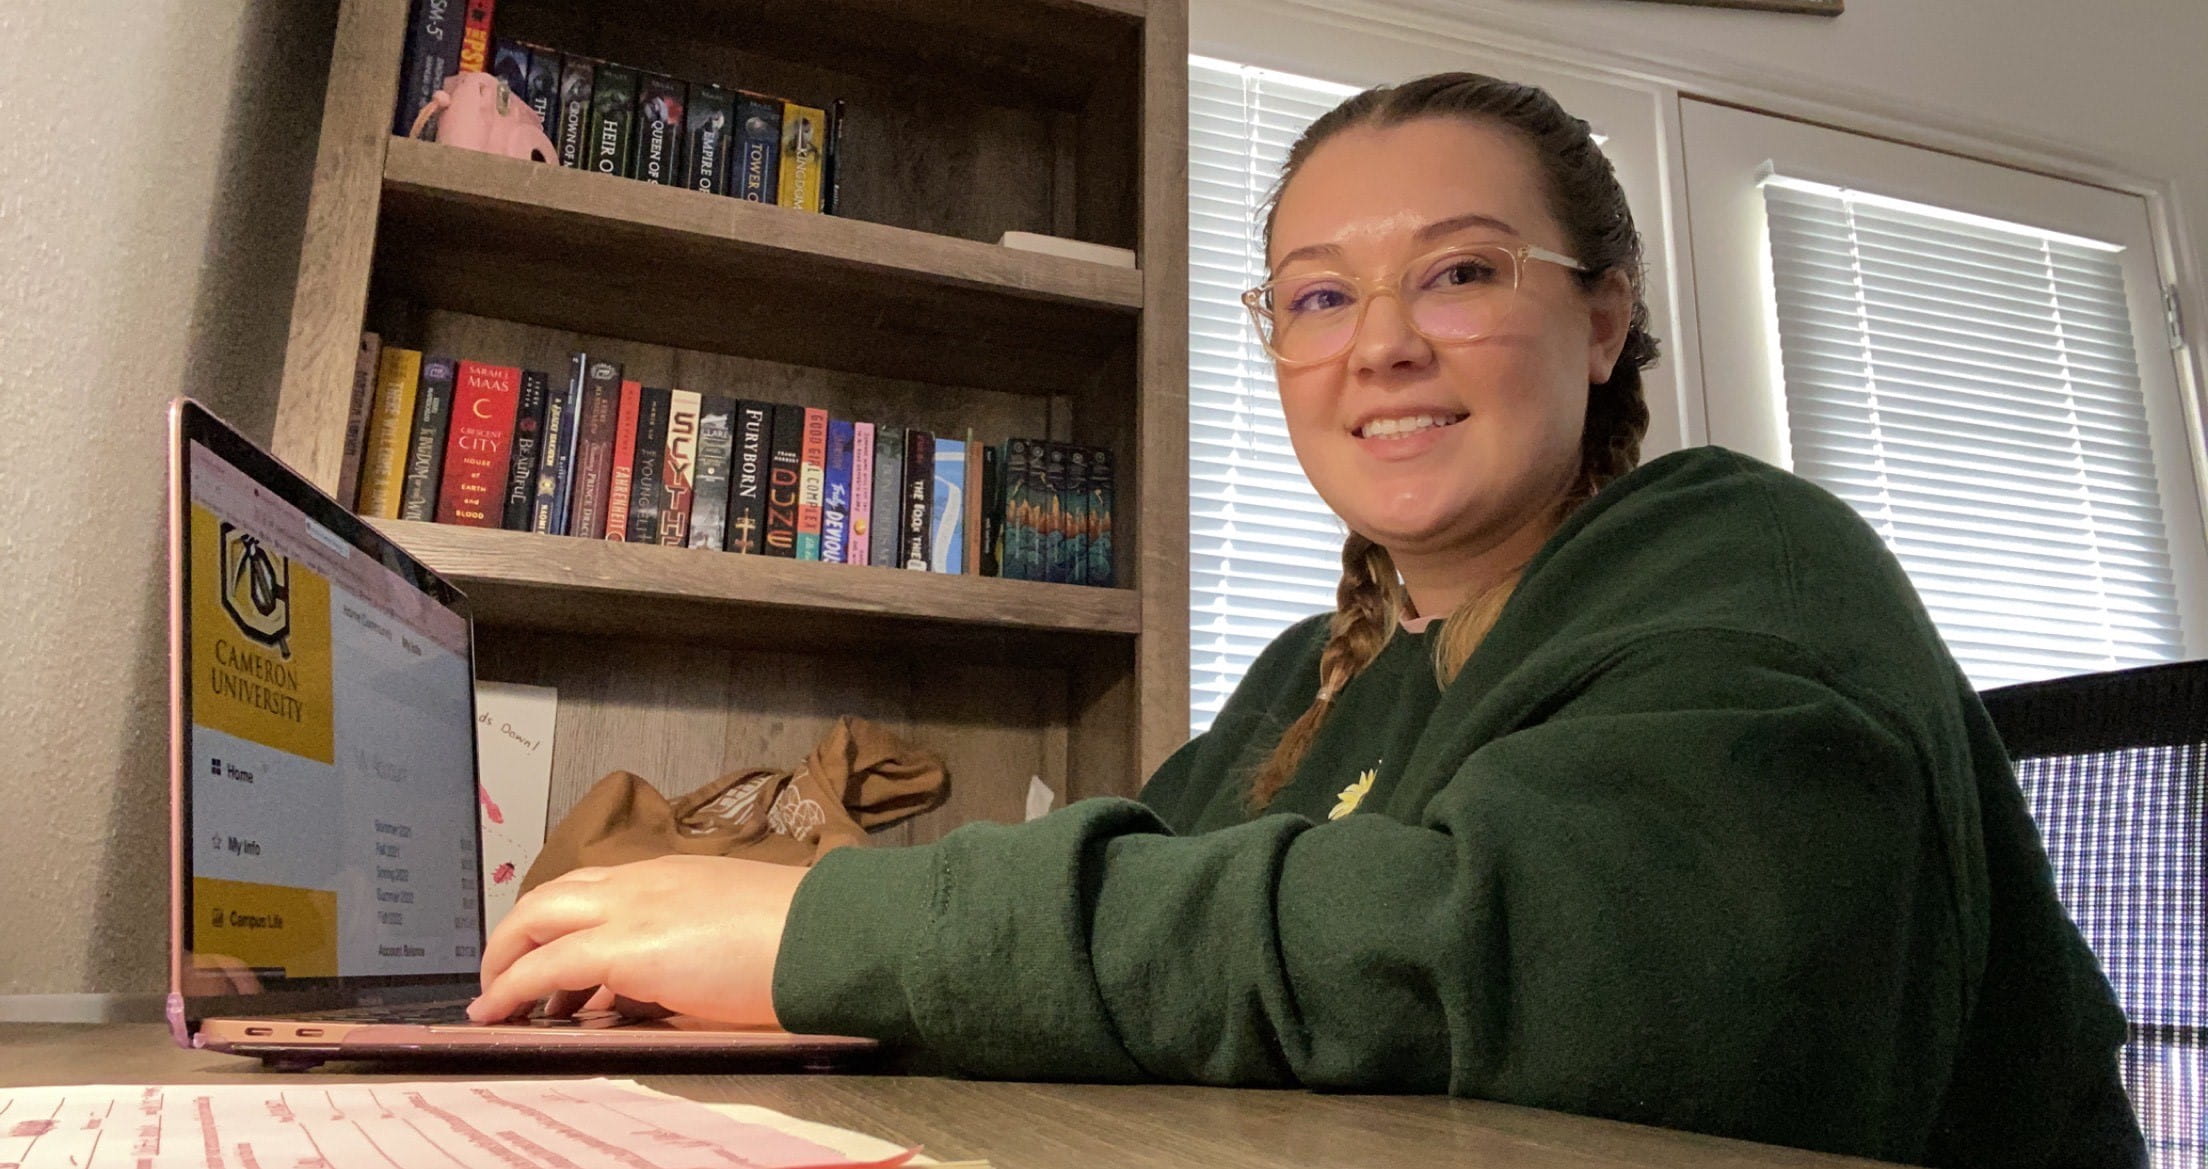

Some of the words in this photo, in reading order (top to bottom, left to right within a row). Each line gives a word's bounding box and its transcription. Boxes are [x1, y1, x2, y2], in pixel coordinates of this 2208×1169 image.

[600, 120, 618, 156] HEIR
[651, 120, 664, 161] QUEEN
[564, 145, 576, 160] OF
[701, 130, 715, 176] EMPIRE
[599, 160, 614, 174] O
[648, 162, 660, 180] OF
[749, 143, 763, 188] TOWER
[747, 191, 759, 203] O
[468, 376, 509, 392] MAAS
[809, 415, 824, 442] GOOD
[408, 427, 437, 480] KINGDOM
[458, 436, 501, 453] CITY
[739, 409, 763, 499] FURYBORN
[464, 457, 491, 467] HOUSE
[808, 448, 822, 473] GIRL
[461, 484, 486, 493] EARTH
[639, 458, 655, 508] YOUNG
[914, 480, 924, 500] THE
[610, 466, 630, 529] FAHRENHEIT
[804, 474, 821, 529] COMPLEX
[456, 509, 485, 520] BLOOD
[215, 639, 298, 691] CAMERON
[211, 667, 303, 723] UNIVERSITY
[478, 712, 493, 725] ds
[227, 763, 254, 784] Home
[228, 836, 241, 856] My
[243, 839, 261, 856] Info
[229, 911, 267, 930] Campus
[268, 914, 284, 929] Life
